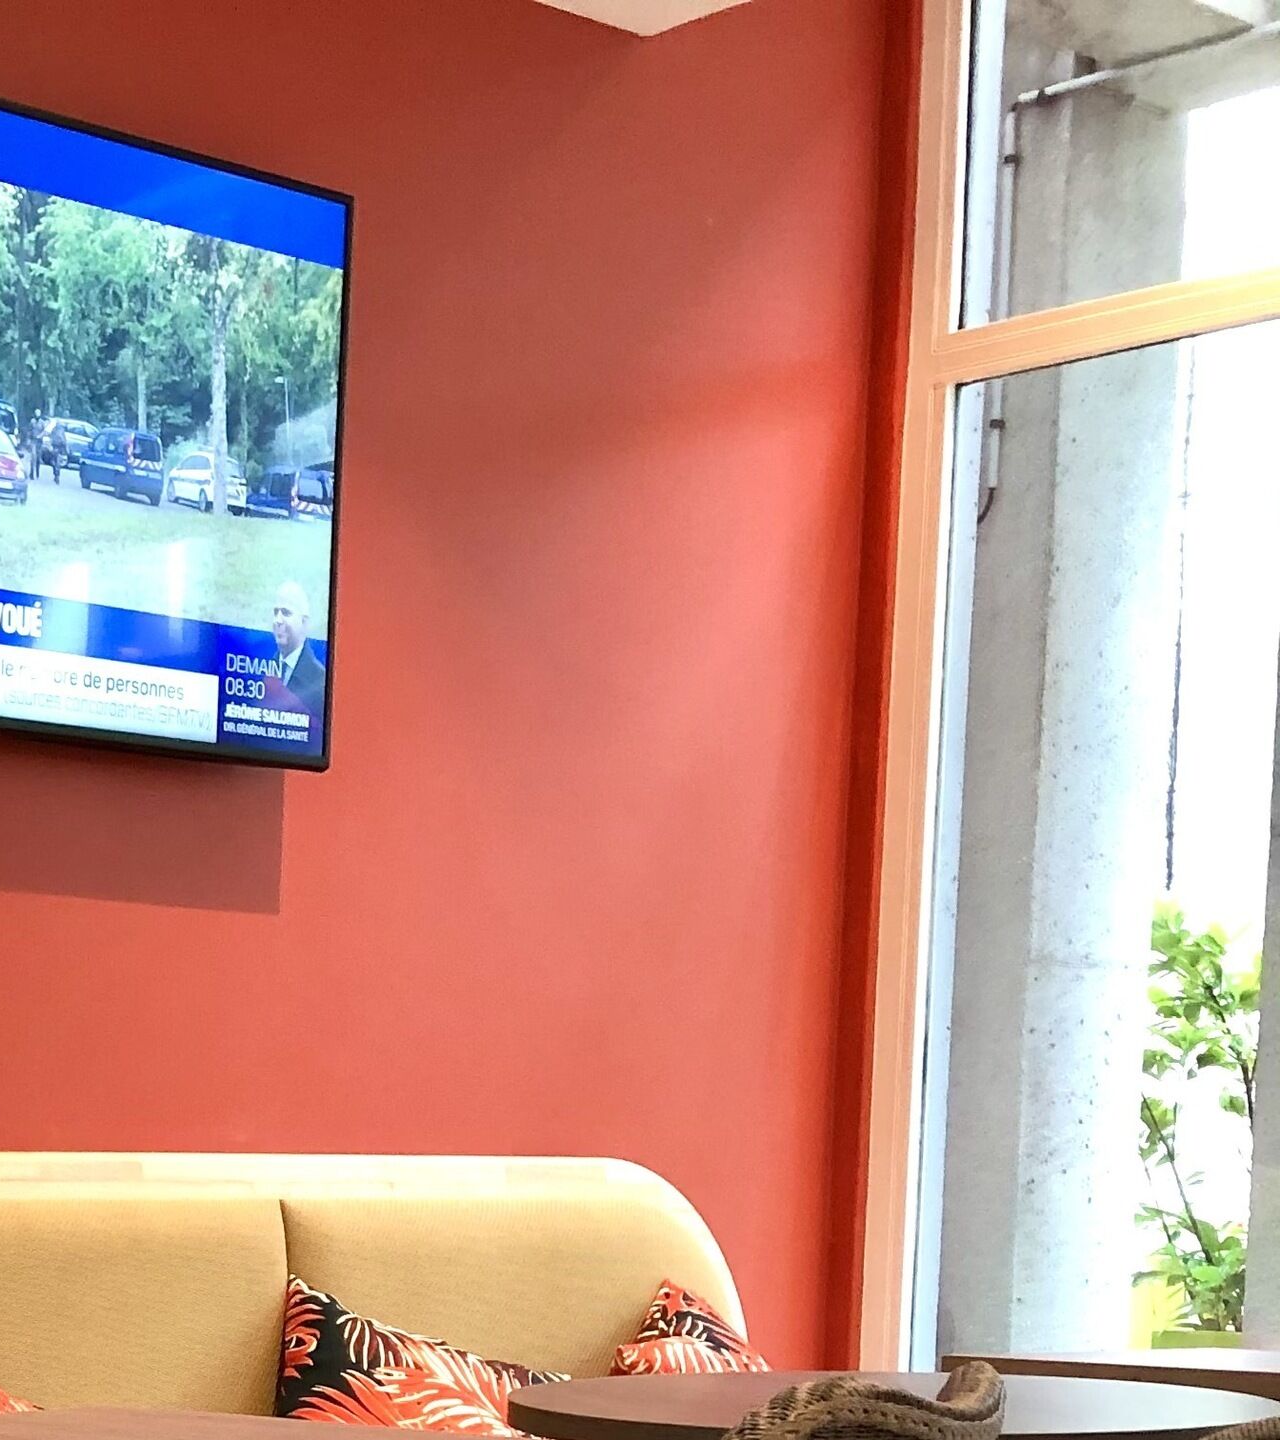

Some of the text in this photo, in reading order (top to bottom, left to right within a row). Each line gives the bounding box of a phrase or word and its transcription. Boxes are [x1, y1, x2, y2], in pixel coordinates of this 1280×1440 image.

[226, 653, 282, 678] DEMAIN
[0, 658, 14, 677] le
[82, 671, 102, 689] de
[105, 675, 185, 702] personnes
[225, 676, 266, 700] 08.30
